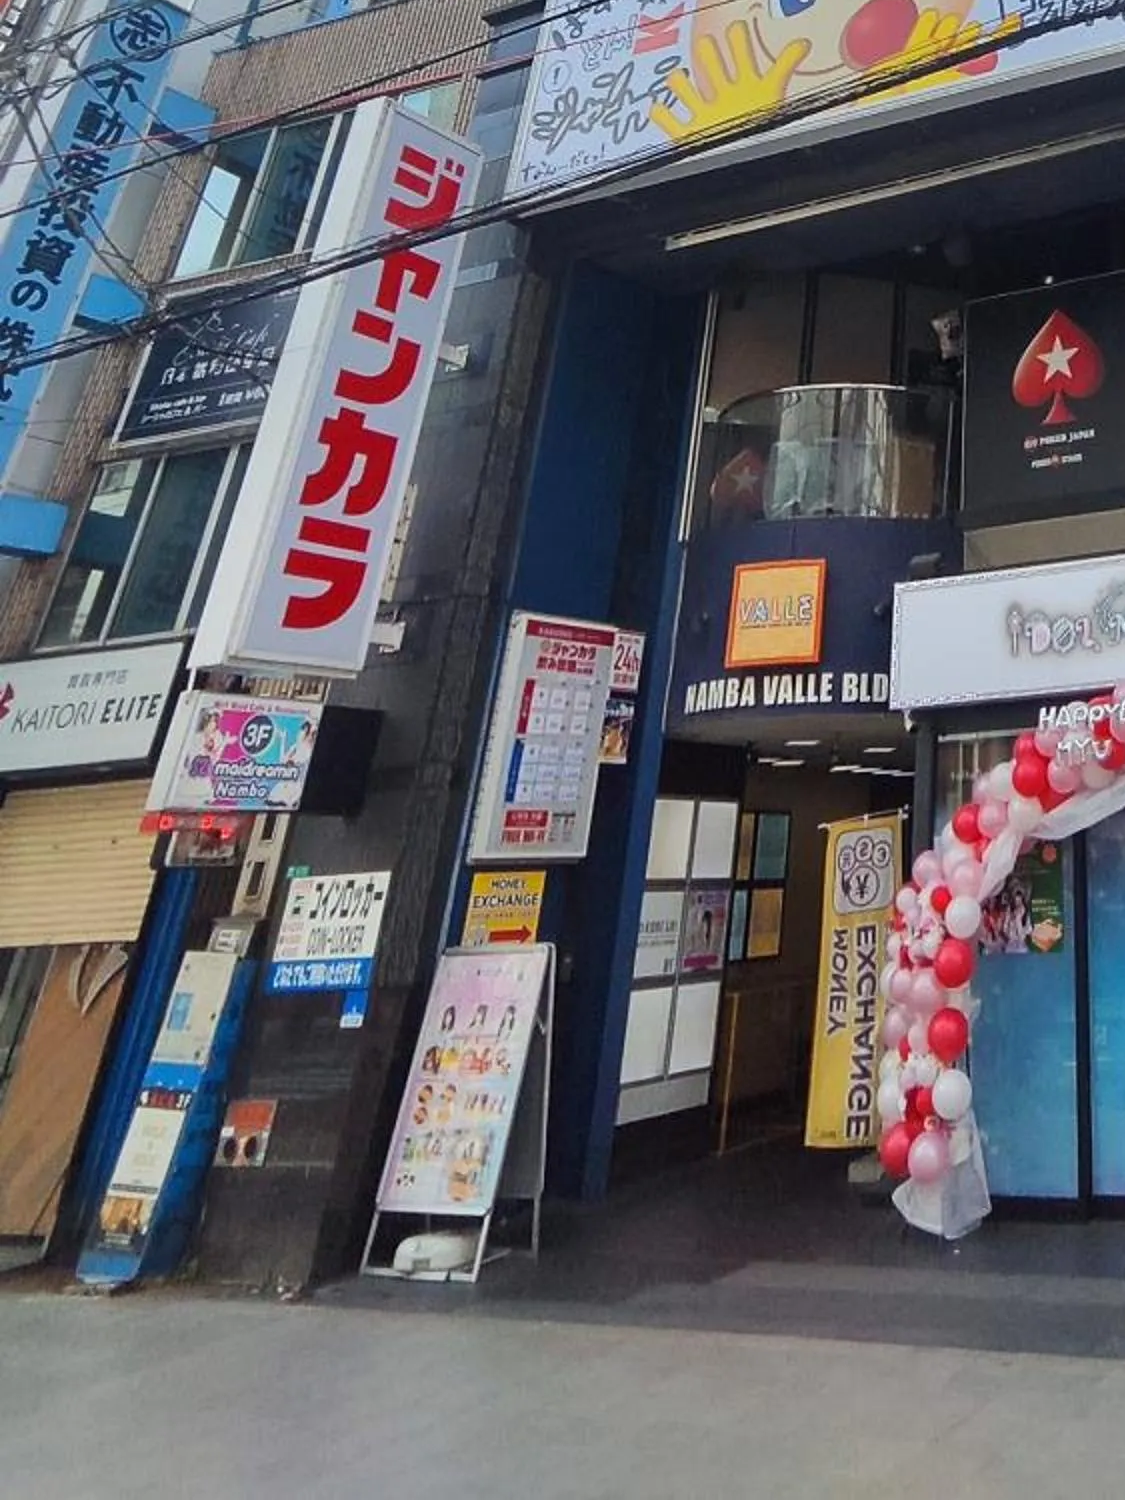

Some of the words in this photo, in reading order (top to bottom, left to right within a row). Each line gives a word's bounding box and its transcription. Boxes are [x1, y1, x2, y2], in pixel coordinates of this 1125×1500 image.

[282, 145, 465, 630] ジャンカラ
[741, 594, 814, 621] VALLE
[684, 676, 755, 714] NAMBA
[763, 672, 834, 706] VALLE
[10, 700, 97, 734] KAITORI
[100, 693, 162, 725] ELITE
[1038, 705, 1120, 732] HAPPY
[243, 723, 273, 748] 3F
[214, 758, 300, 781] maidreamin
[472, 892, 540, 909] EXCHANGE
